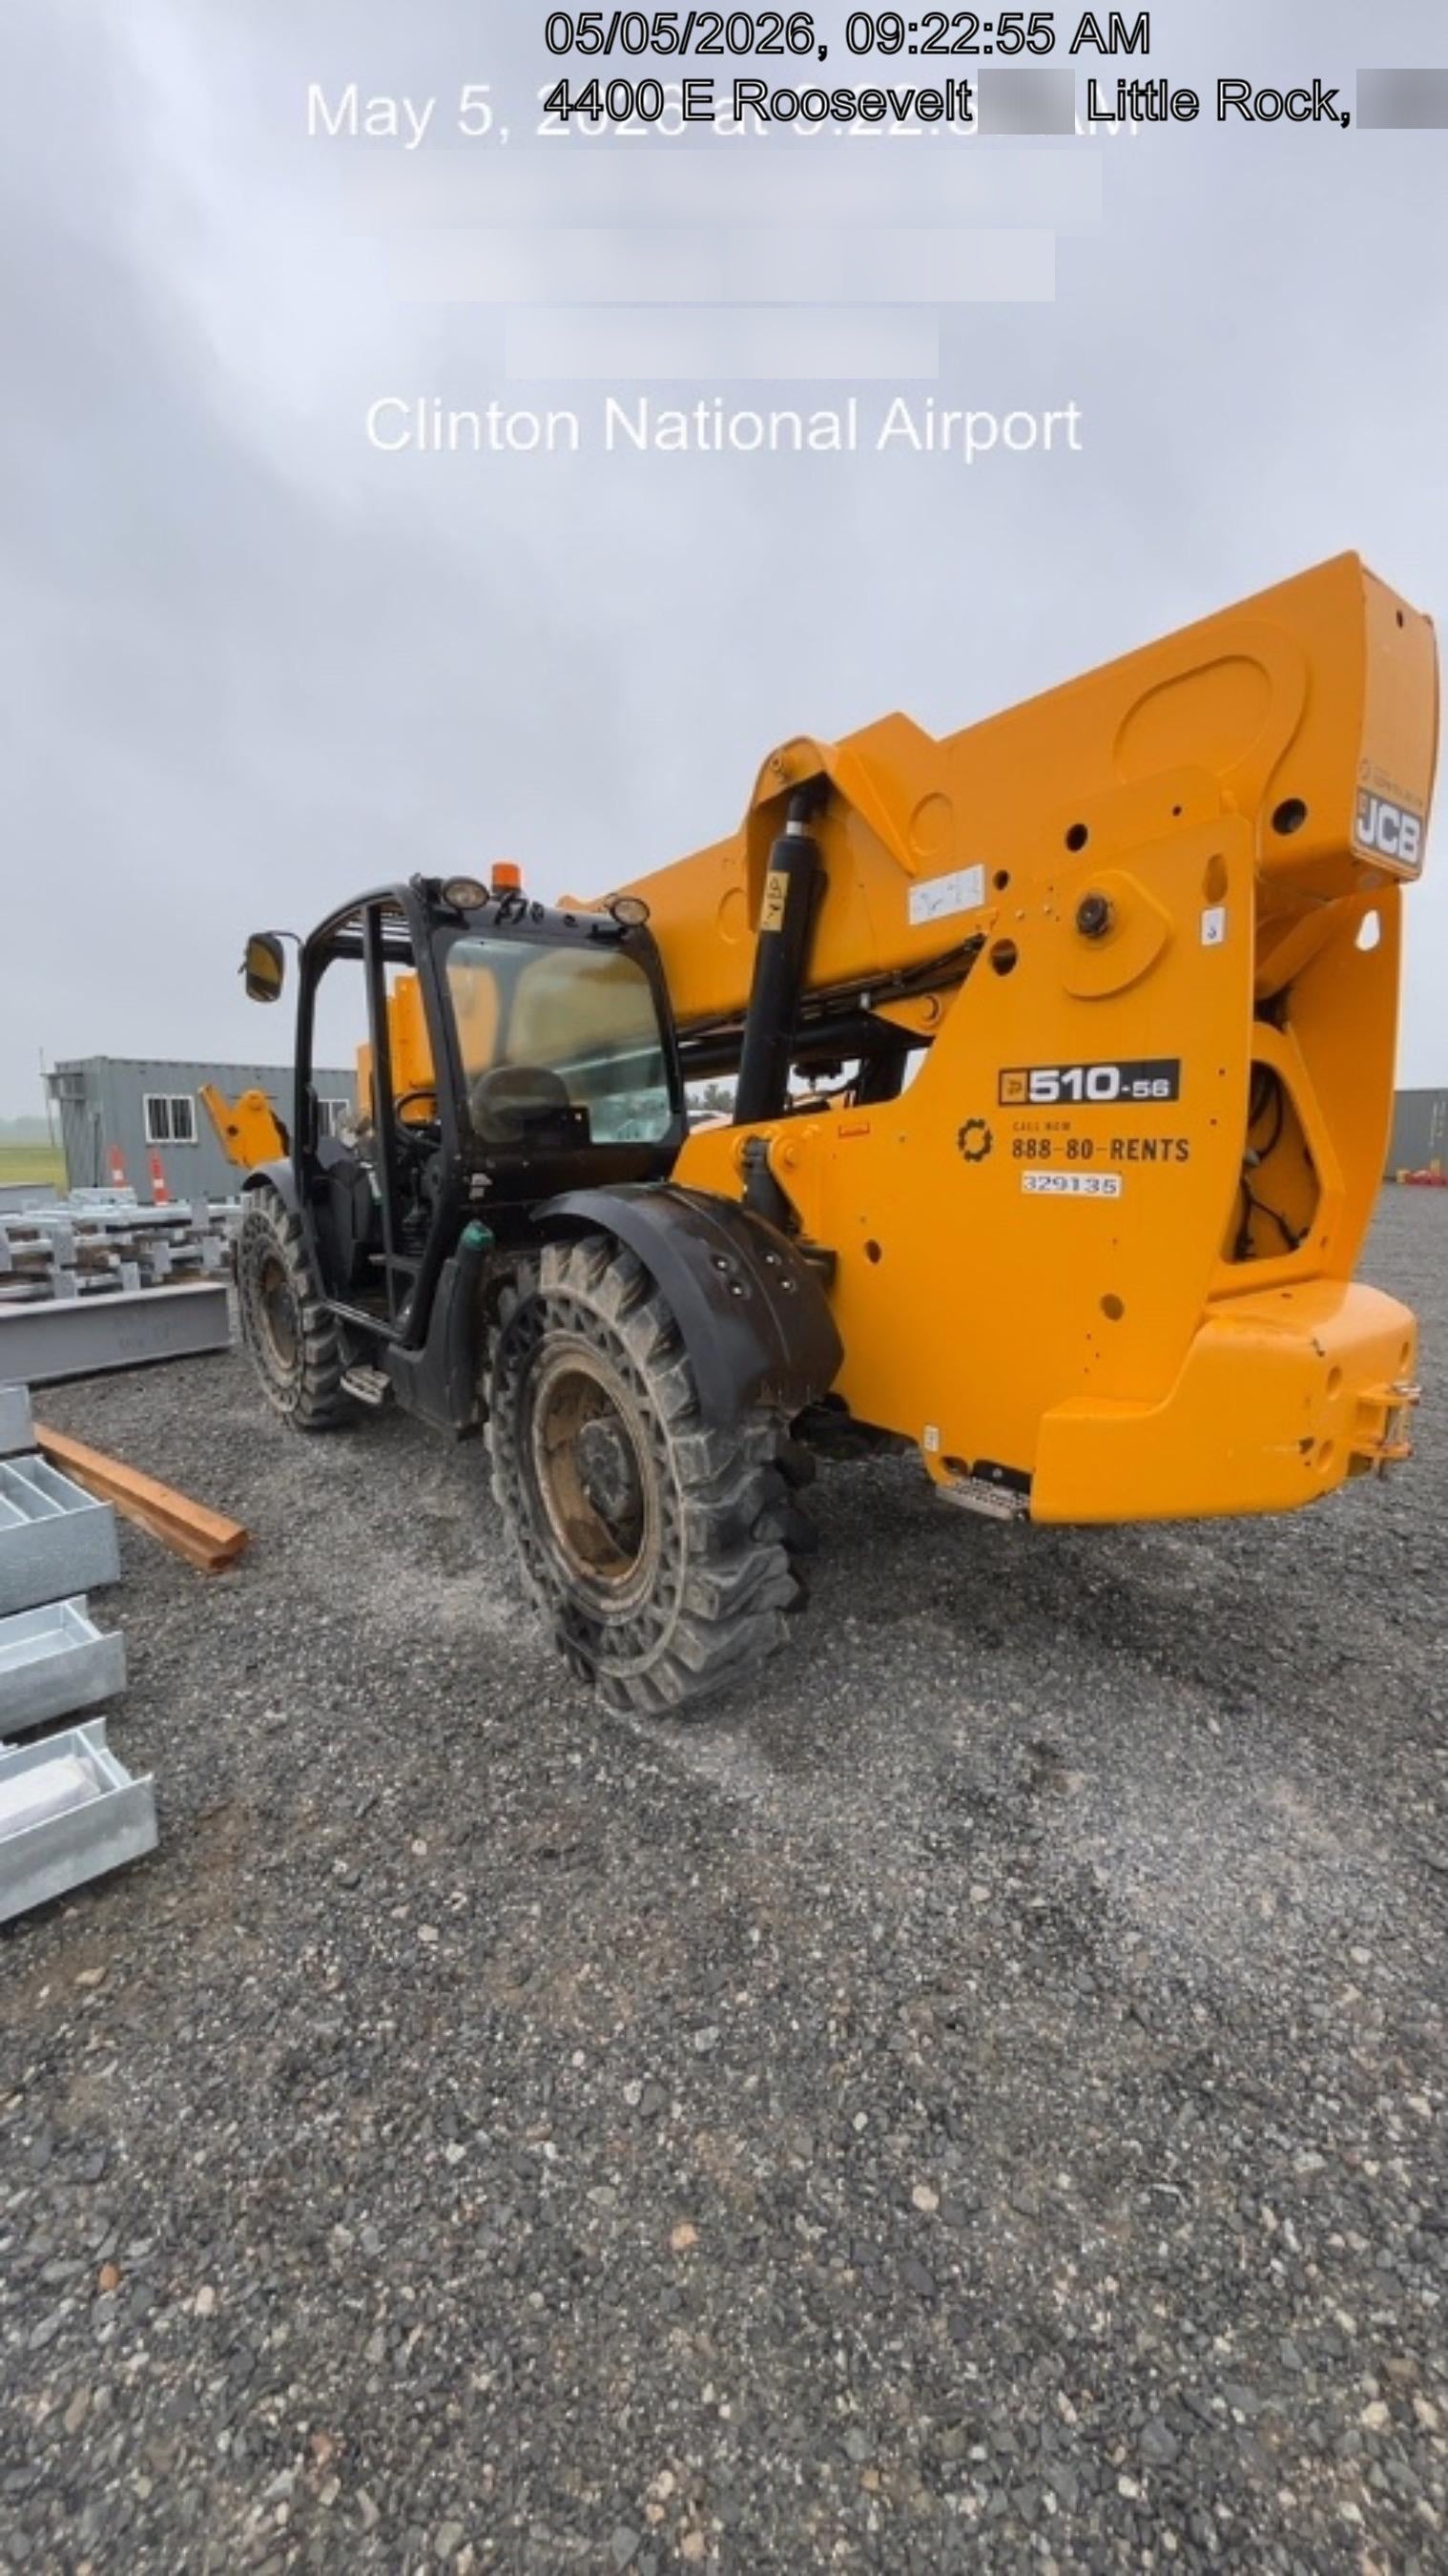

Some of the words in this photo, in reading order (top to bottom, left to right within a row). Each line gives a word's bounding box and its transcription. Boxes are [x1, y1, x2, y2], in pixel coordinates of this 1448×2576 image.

[1357, 798, 1420, 863] JCB
[1029, 1066, 1170, 1103] 510-56
[1013, 1121, 1041, 1132] CALL
[1045, 1121, 1071, 1132] NOW
[1012, 1138, 1189, 1163] 888-80-RENTS
[1024, 1174, 1118, 1195] 329135
